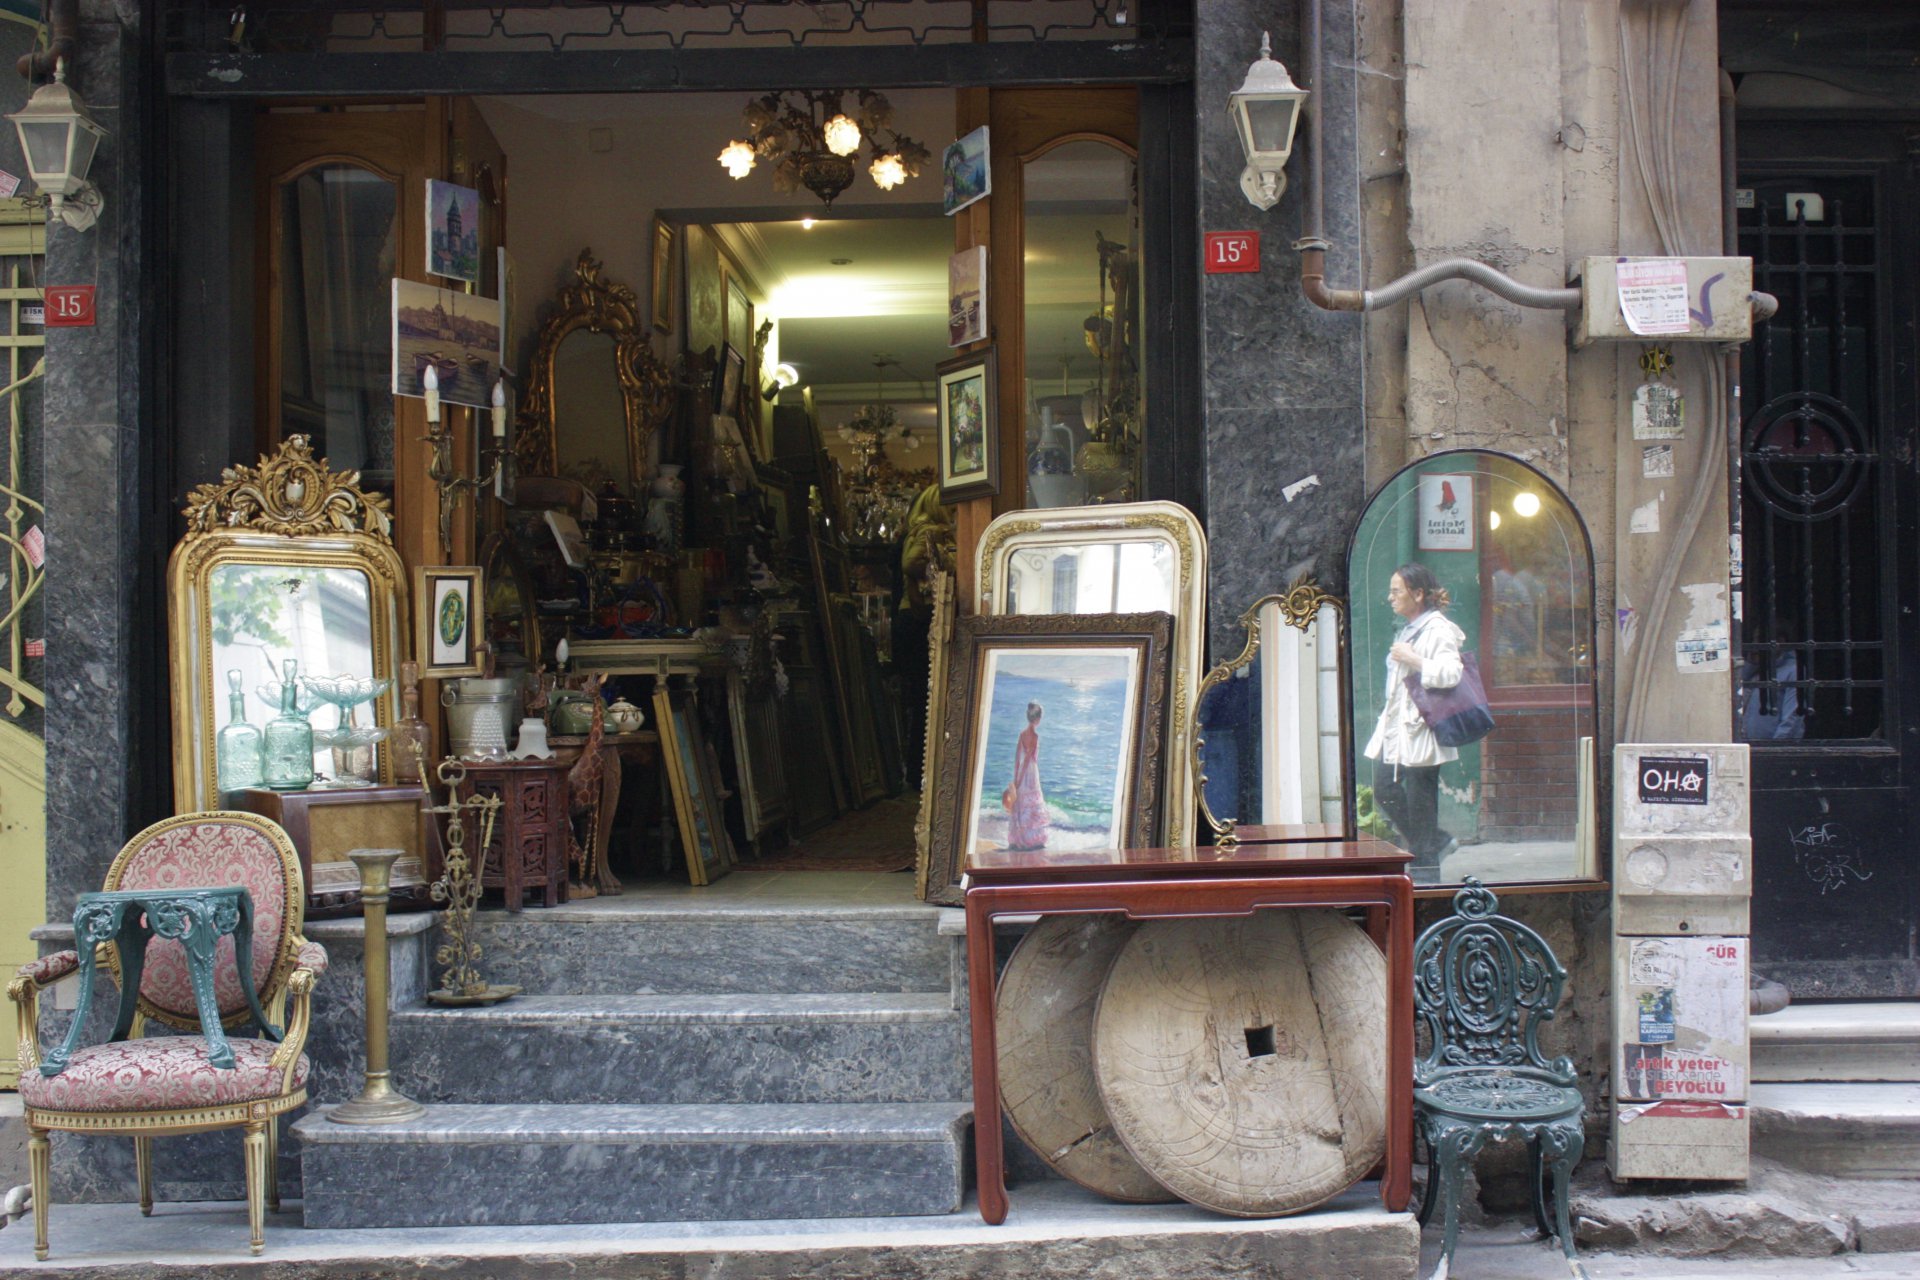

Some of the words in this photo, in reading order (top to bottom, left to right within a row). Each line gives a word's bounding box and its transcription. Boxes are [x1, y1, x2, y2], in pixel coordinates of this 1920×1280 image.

[58, 295, 81, 317] 15
[1637, 1056, 1673, 1070] artık
[1678, 1058, 1720, 1072] yeter
[1683, 1070, 1722, 1082] sende
